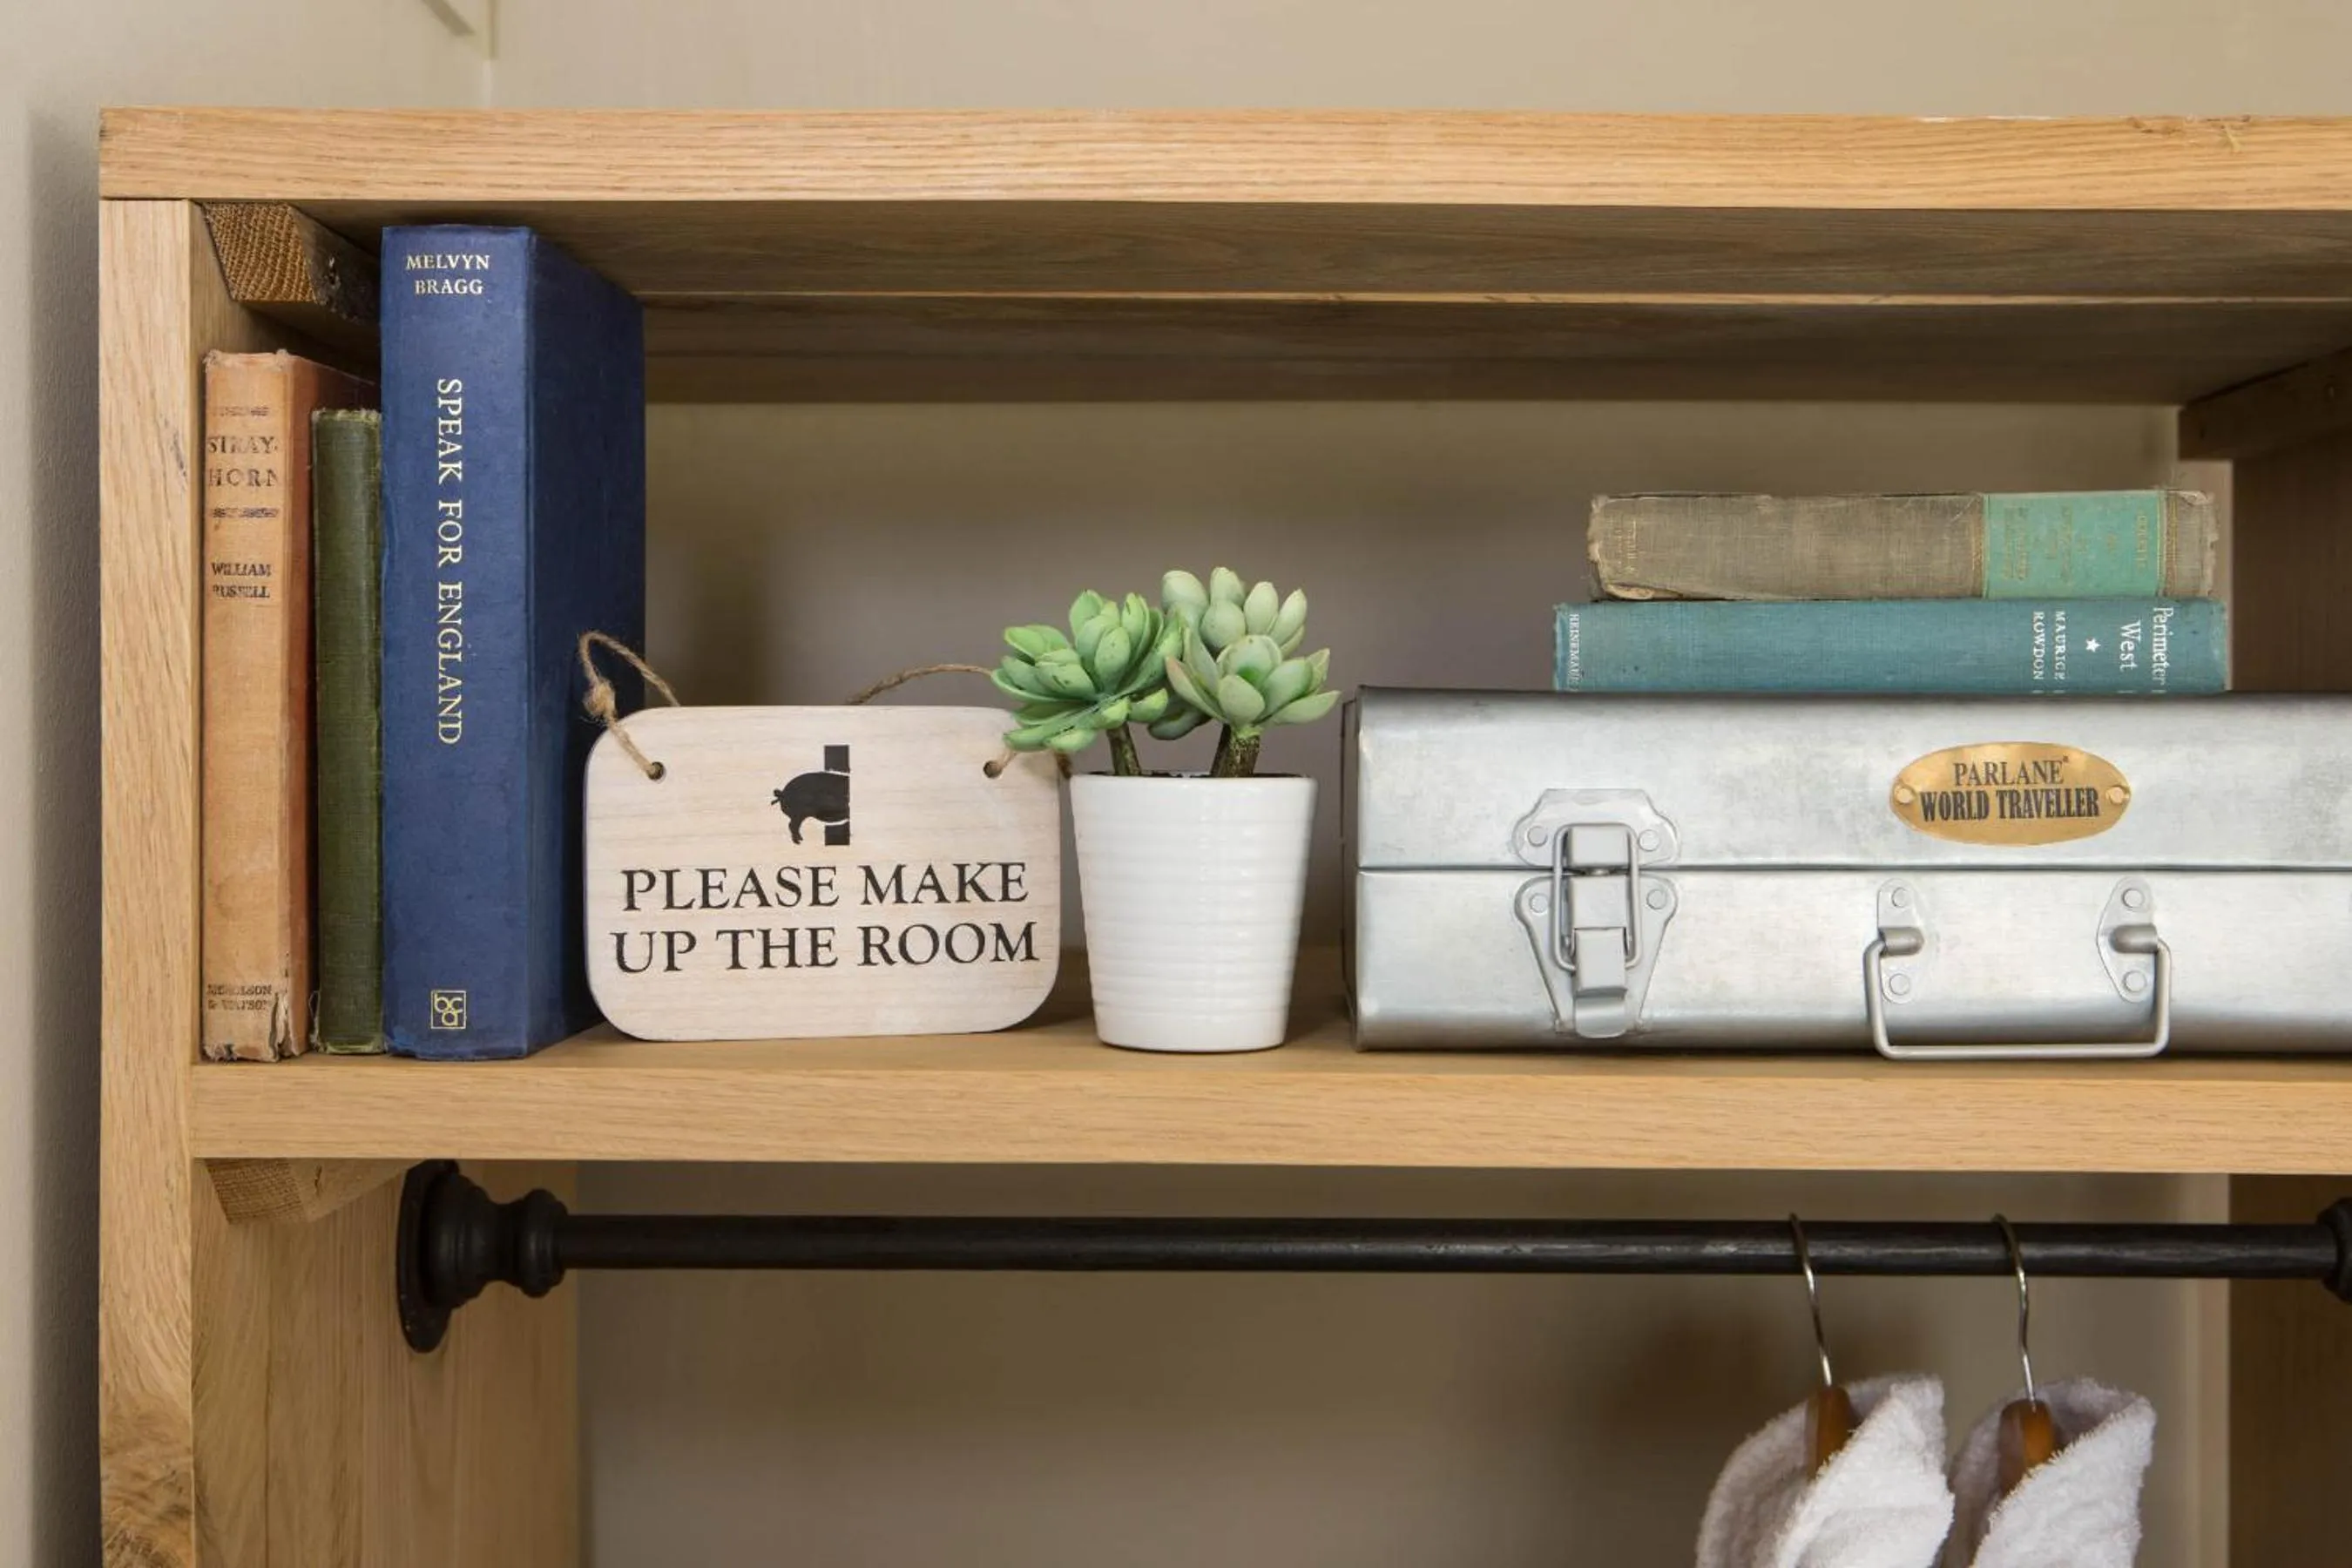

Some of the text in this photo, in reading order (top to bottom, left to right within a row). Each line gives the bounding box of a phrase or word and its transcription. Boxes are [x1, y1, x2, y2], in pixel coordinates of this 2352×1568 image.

[405, 253, 490, 271] MELVYN
[414, 278, 484, 295] BRAGG
[211, 562, 271, 578] WILLIAM
[436, 378, 463, 745] SPEAK FOR ENGLAND
[2031, 611, 2045, 680] ROWDON
[2119, 619, 2141, 672] West
[2151, 606, 2174, 686] Perimeter
[1920, 787, 2100, 821] WORLD TRAVELLER
[621, 862, 1030, 911] PLEASE MAKE
[610, 922, 1040, 974] UP THE ROOM
